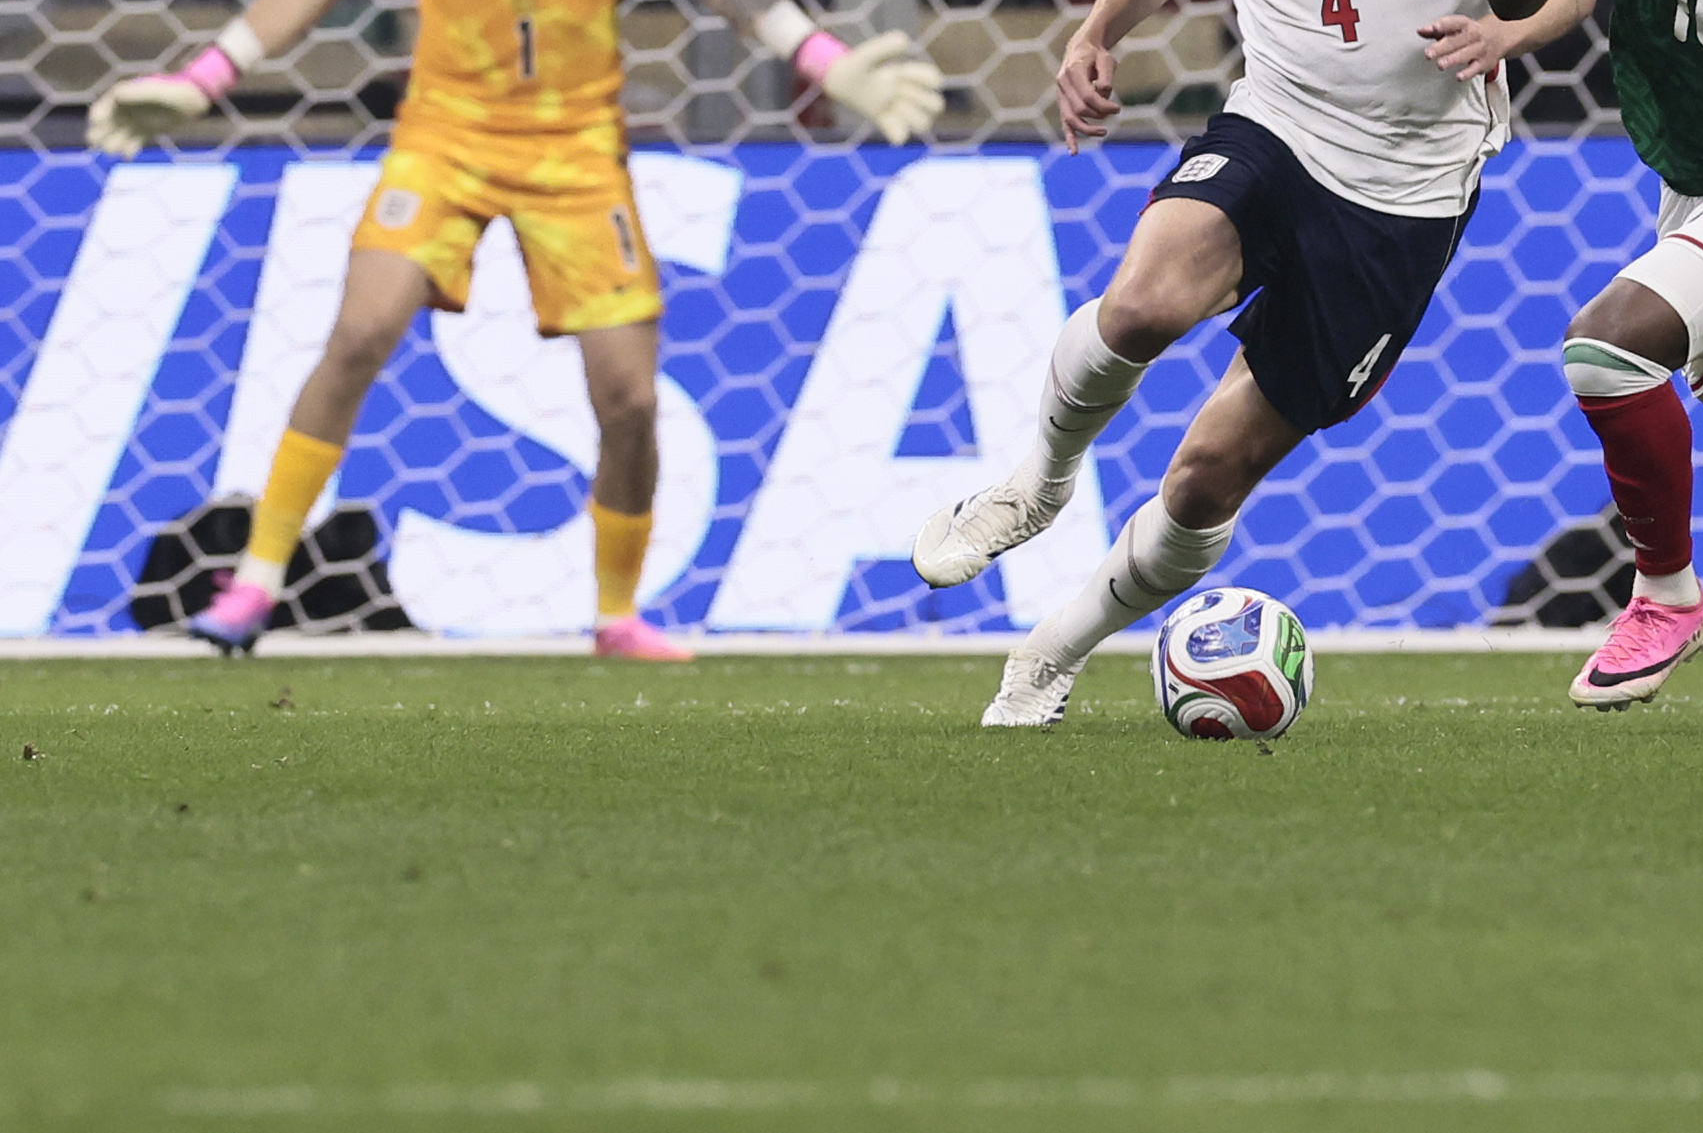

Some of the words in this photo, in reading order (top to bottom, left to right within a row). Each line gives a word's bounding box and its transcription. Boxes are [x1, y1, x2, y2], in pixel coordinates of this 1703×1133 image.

[518, 17, 535, 79] 1
[612, 205, 638, 269] 1
[1347, 333, 1392, 399] 4
